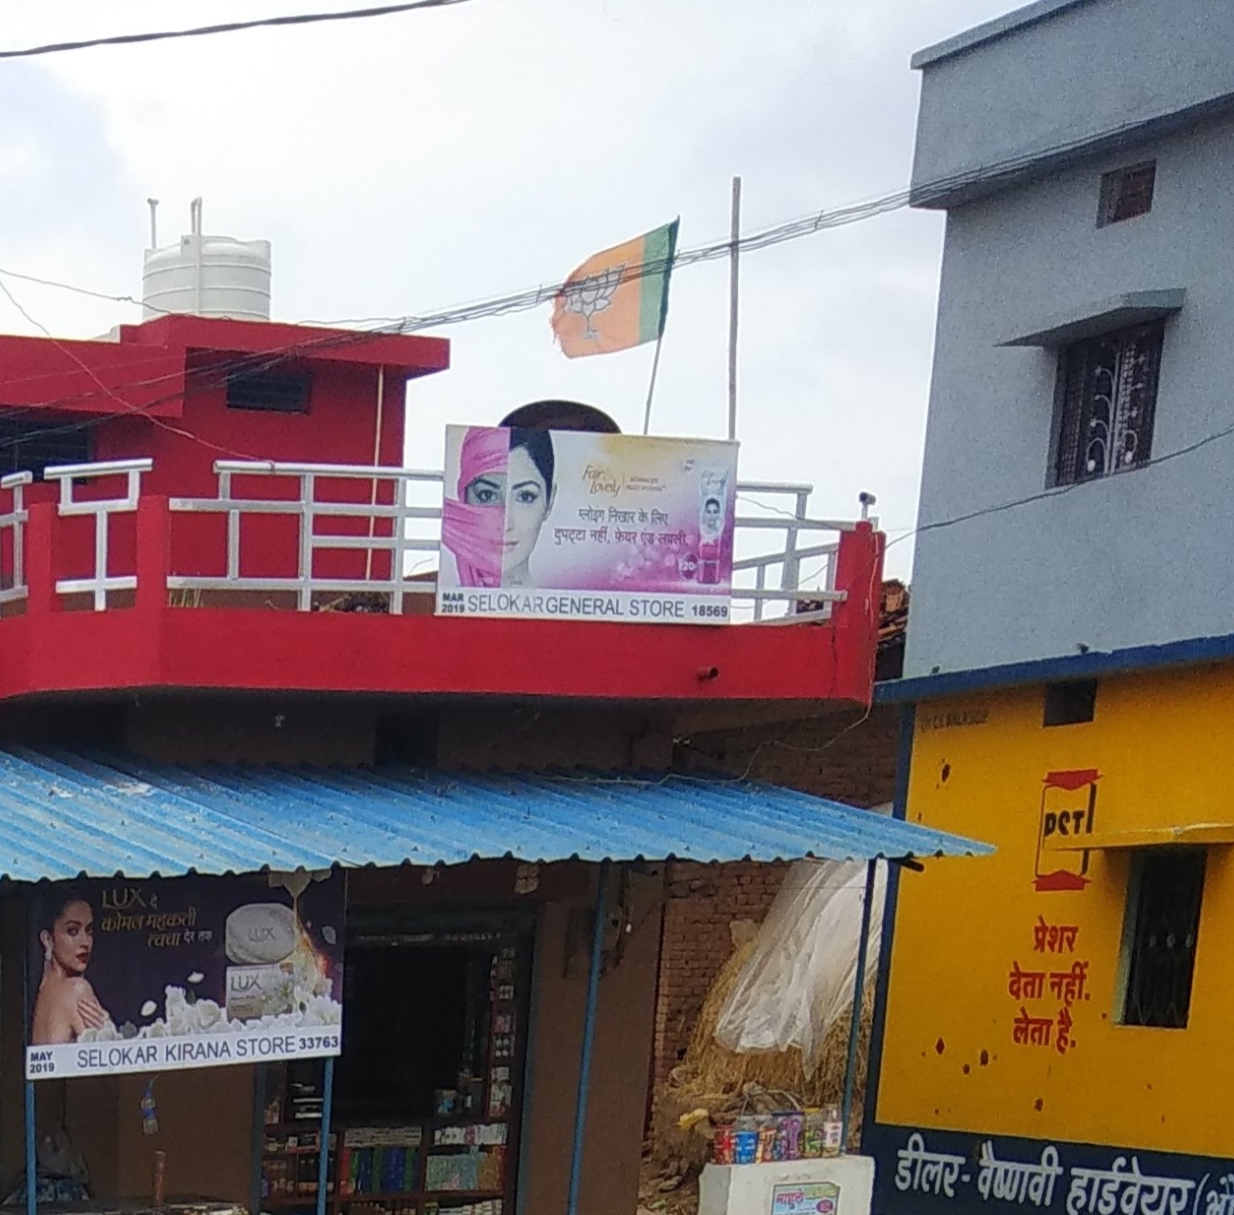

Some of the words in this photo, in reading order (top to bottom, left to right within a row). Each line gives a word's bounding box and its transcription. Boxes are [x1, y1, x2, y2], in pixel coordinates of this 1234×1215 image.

[589, 480, 621, 497] Lovely
[608, 505, 635, 523] निखार
[638, 507, 648, 523] के
[650, 508, 668, 525] लिए
[443, 593, 464, 602] MAR
[467, 594, 545, 614] SELOKAR
[546, 598, 624, 616] GENERAL
[629, 600, 684, 617] STORE
[692, 605, 728, 618] 18569
[441, 604, 465, 614] 2019
[102, 887, 146, 910] LUX
[101, 912, 144, 932] कोमल
[146, 906, 196, 931] महकती
[148, 932, 180, 948] त्वचा
[248, 927, 276, 942] LUX
[1034, 915, 1079, 953] प्रेशर
[230, 974, 262, 992] LUX
[1009, 961, 1045, 1000] देता
[1013, 1006, 1053, 1045] लेता
[30, 1052, 53, 1062] MAY
[77, 1046, 157, 1068] SELOKAR
[166, 1040, 232, 1062] KIRANA
[236, 1036, 296, 1057] STORE
[298, 1035, 339, 1050] 33763
[29, 1062, 55, 1074] 2019
[977, 1140, 1064, 1207] वैष्णवी
